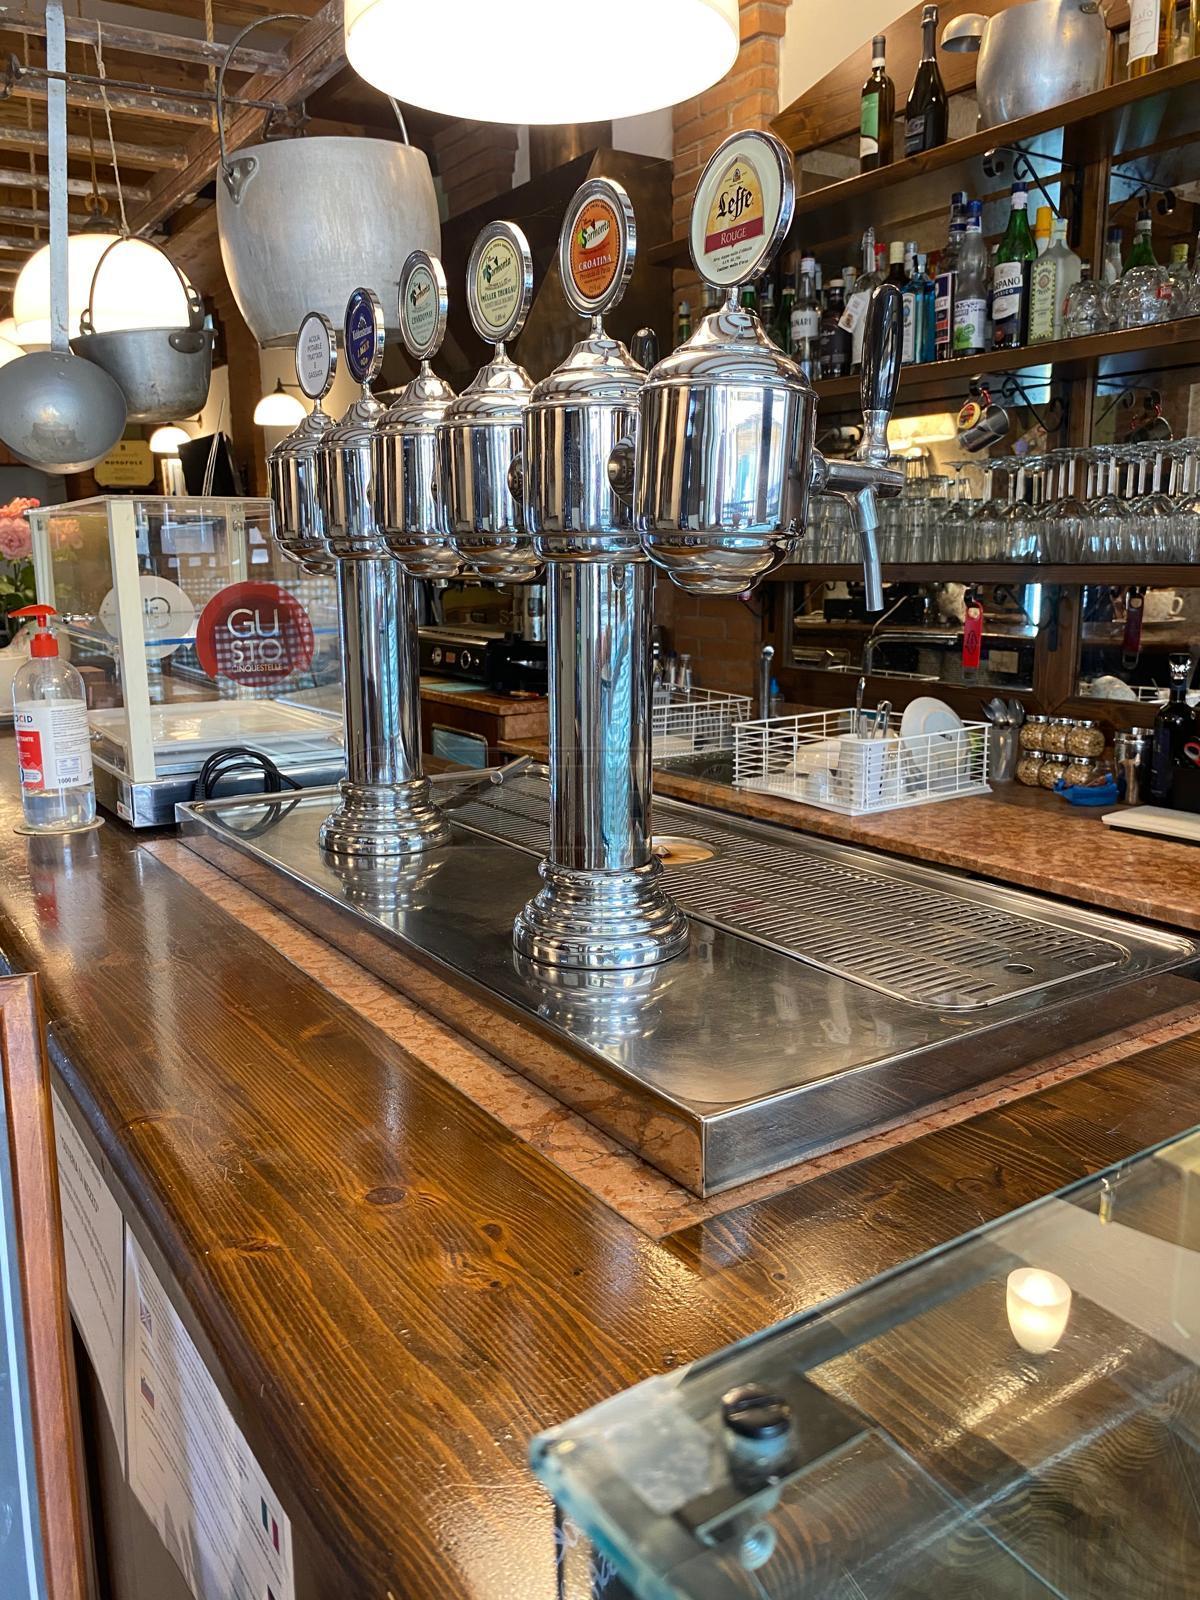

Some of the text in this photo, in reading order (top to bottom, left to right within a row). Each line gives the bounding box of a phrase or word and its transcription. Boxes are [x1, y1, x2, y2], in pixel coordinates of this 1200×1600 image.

[716, 185, 753, 222] Leffe
[578, 254, 612, 271] CROATINA
[227, 608, 280, 638] GU
[230, 638, 282, 663] STO
[231, 663, 283, 673] CINQUESTELLE
